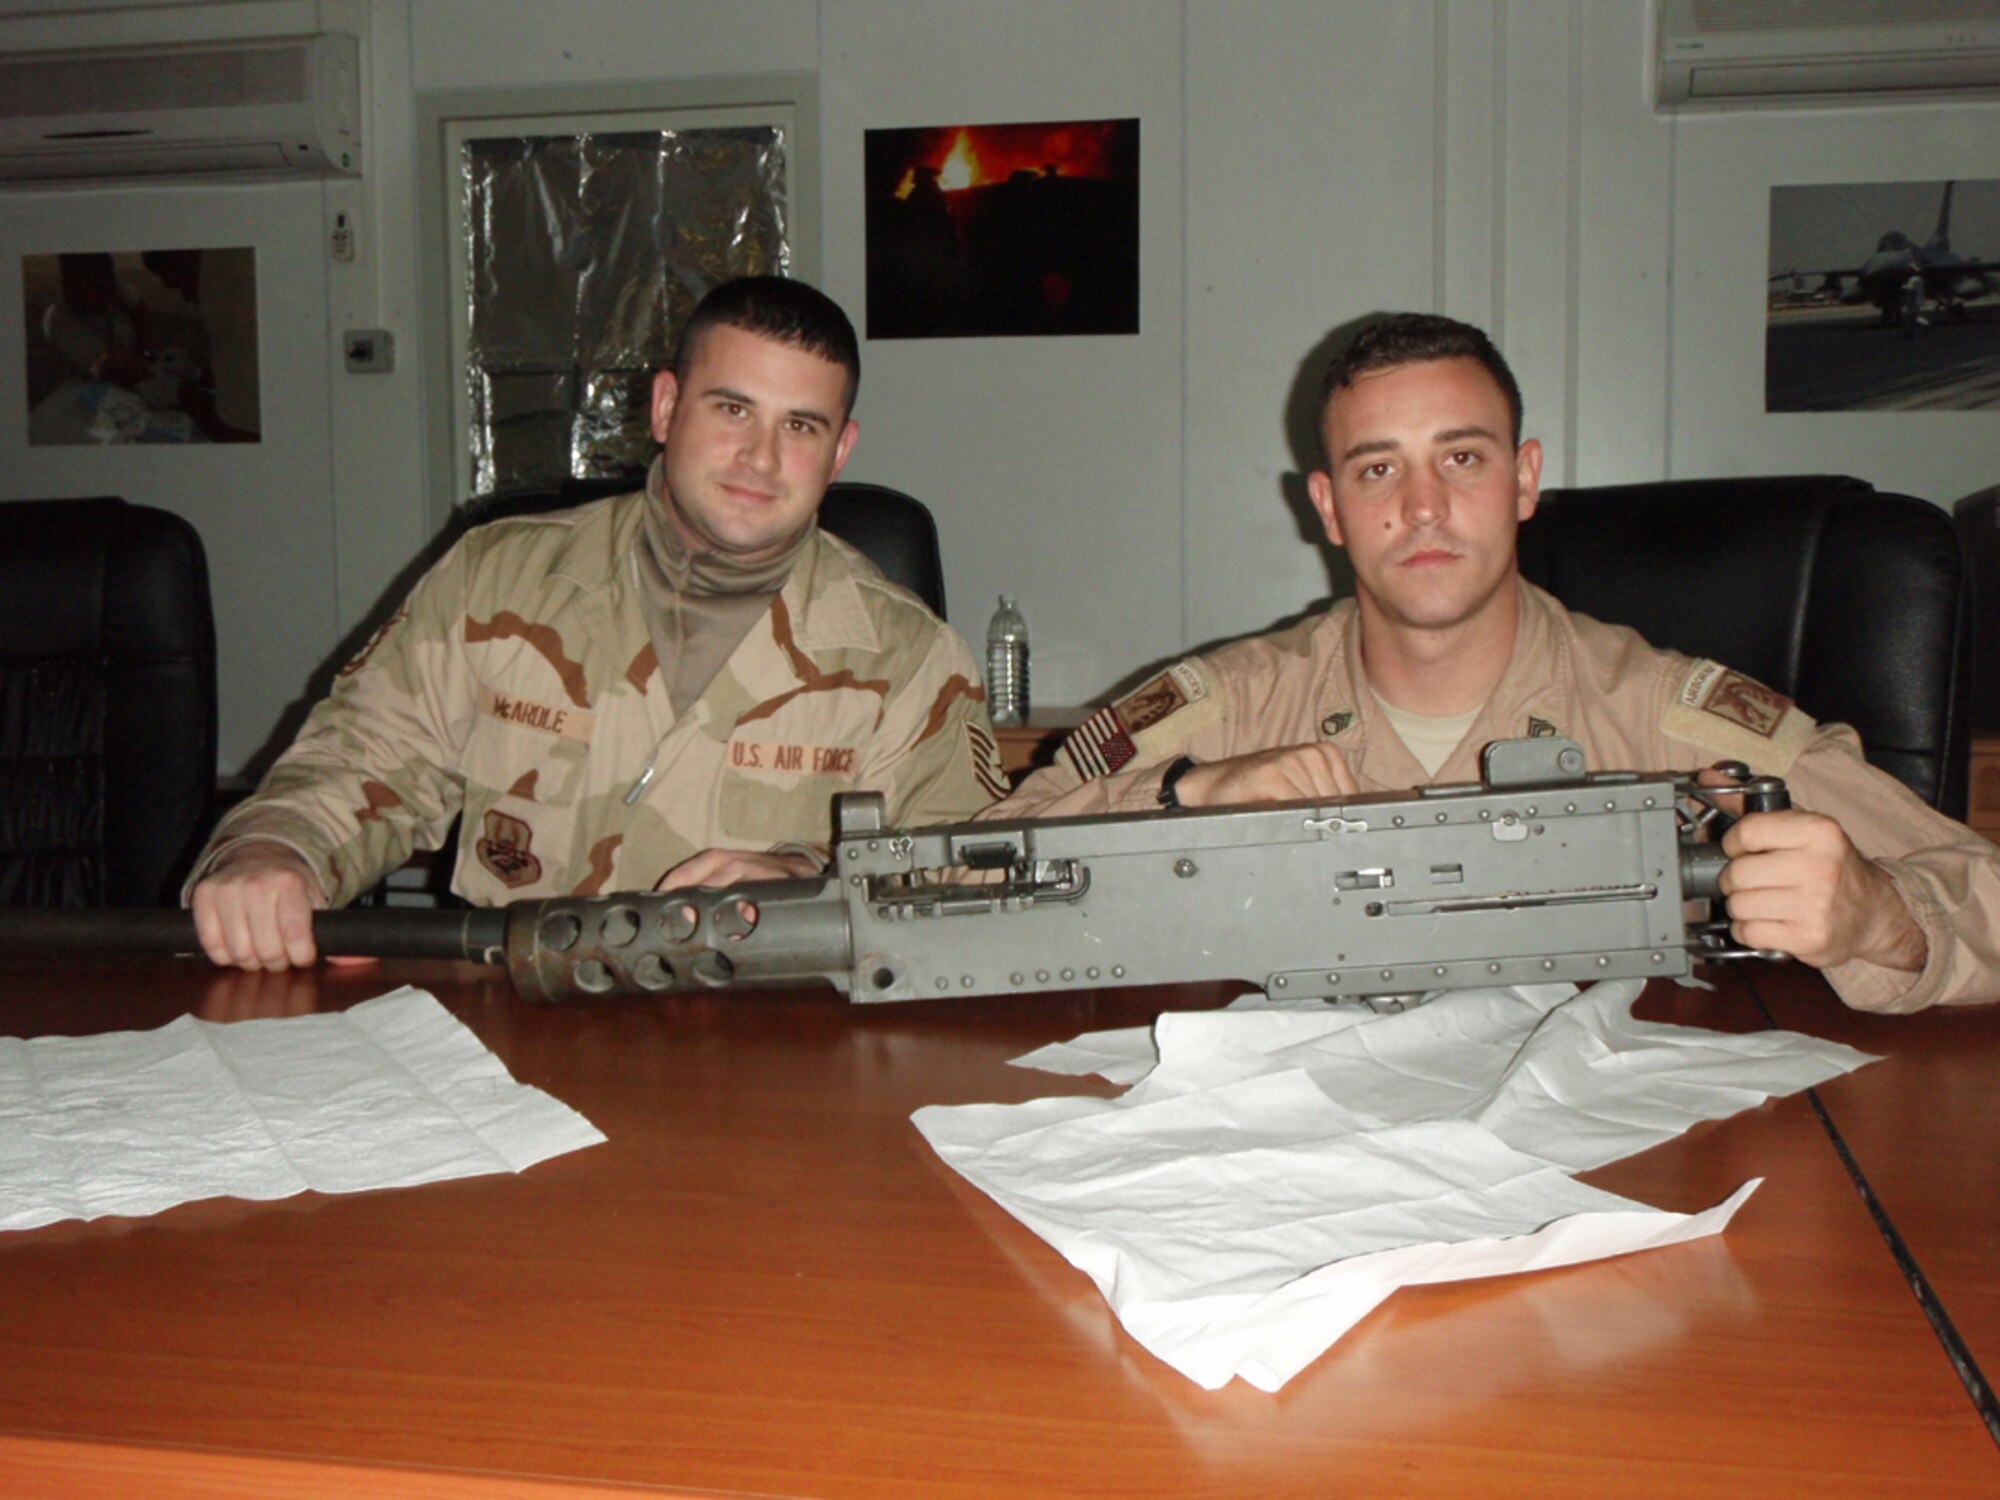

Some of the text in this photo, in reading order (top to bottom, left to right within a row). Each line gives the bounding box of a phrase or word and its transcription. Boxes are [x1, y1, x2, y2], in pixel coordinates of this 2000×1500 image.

[732, 741, 854, 773] U.S. AIR FORCE
